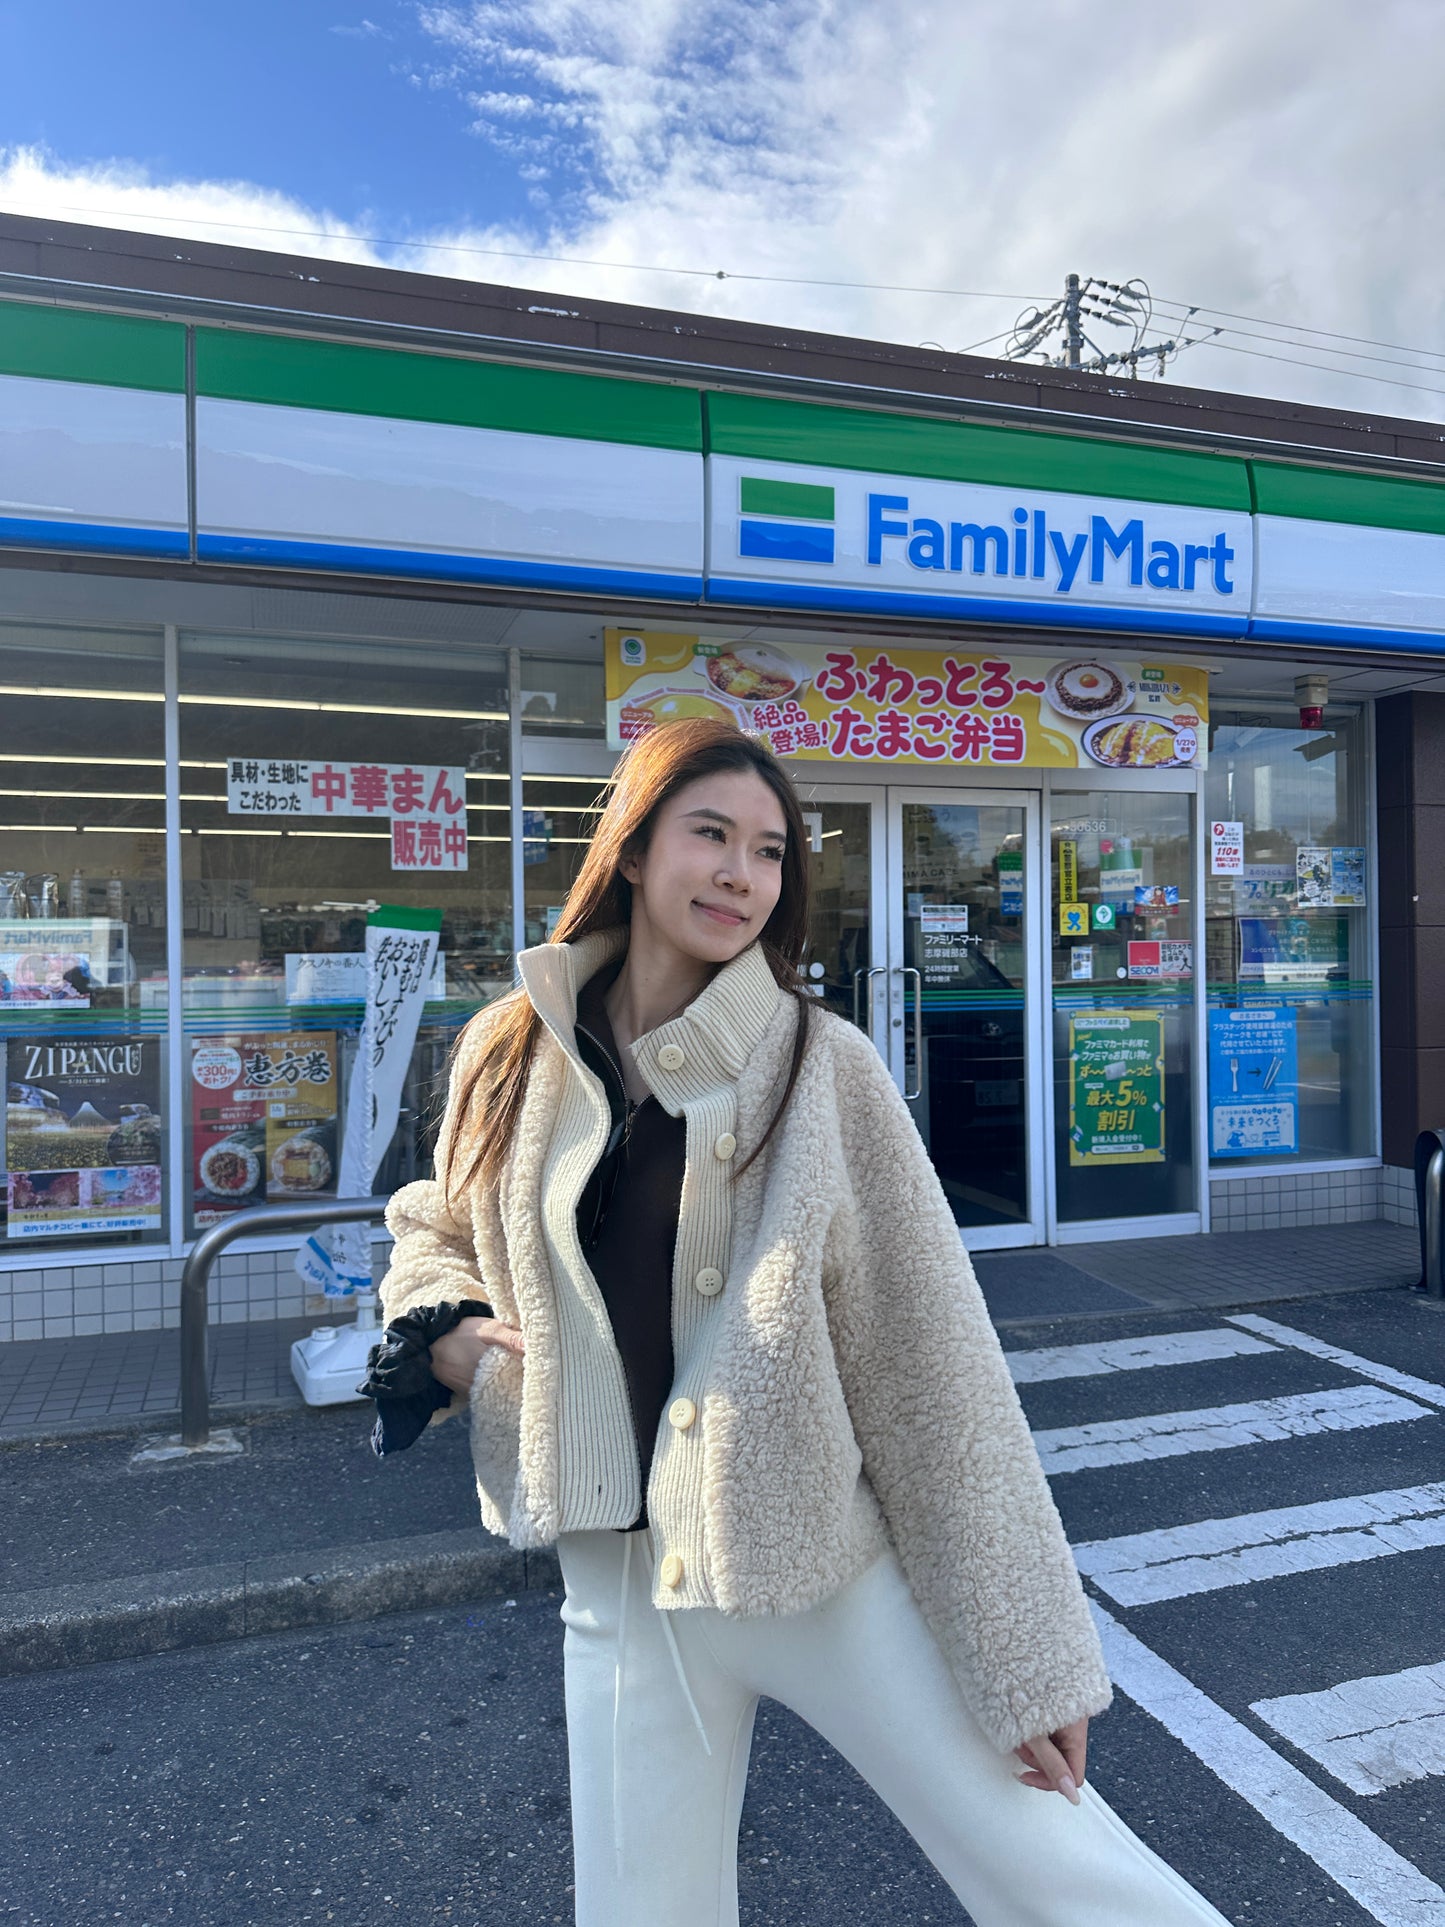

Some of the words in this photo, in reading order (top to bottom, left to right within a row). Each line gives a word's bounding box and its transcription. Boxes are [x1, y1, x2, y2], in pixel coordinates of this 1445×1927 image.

[866, 492, 1234, 594] FamilyMart
[753, 701, 807, 730] 絶品
[770, 722, 829, 755] 登場!
[831, 707, 1025, 761] たまご弁当
[231, 762, 309, 784] 具材・生地に
[312, 764, 464, 815] 中華まん
[239, 790, 301, 811] こだわった
[393, 820, 467, 868] 販売中
[925, 934, 983, 945] ファミリーマート
[1130, 966, 1159, 975] SECOM
[25, 1042, 144, 1080] ZIPANGU
[244, 1051, 332, 1086] 恵方巻
[1097, 1109, 1136, 1131] 割引
